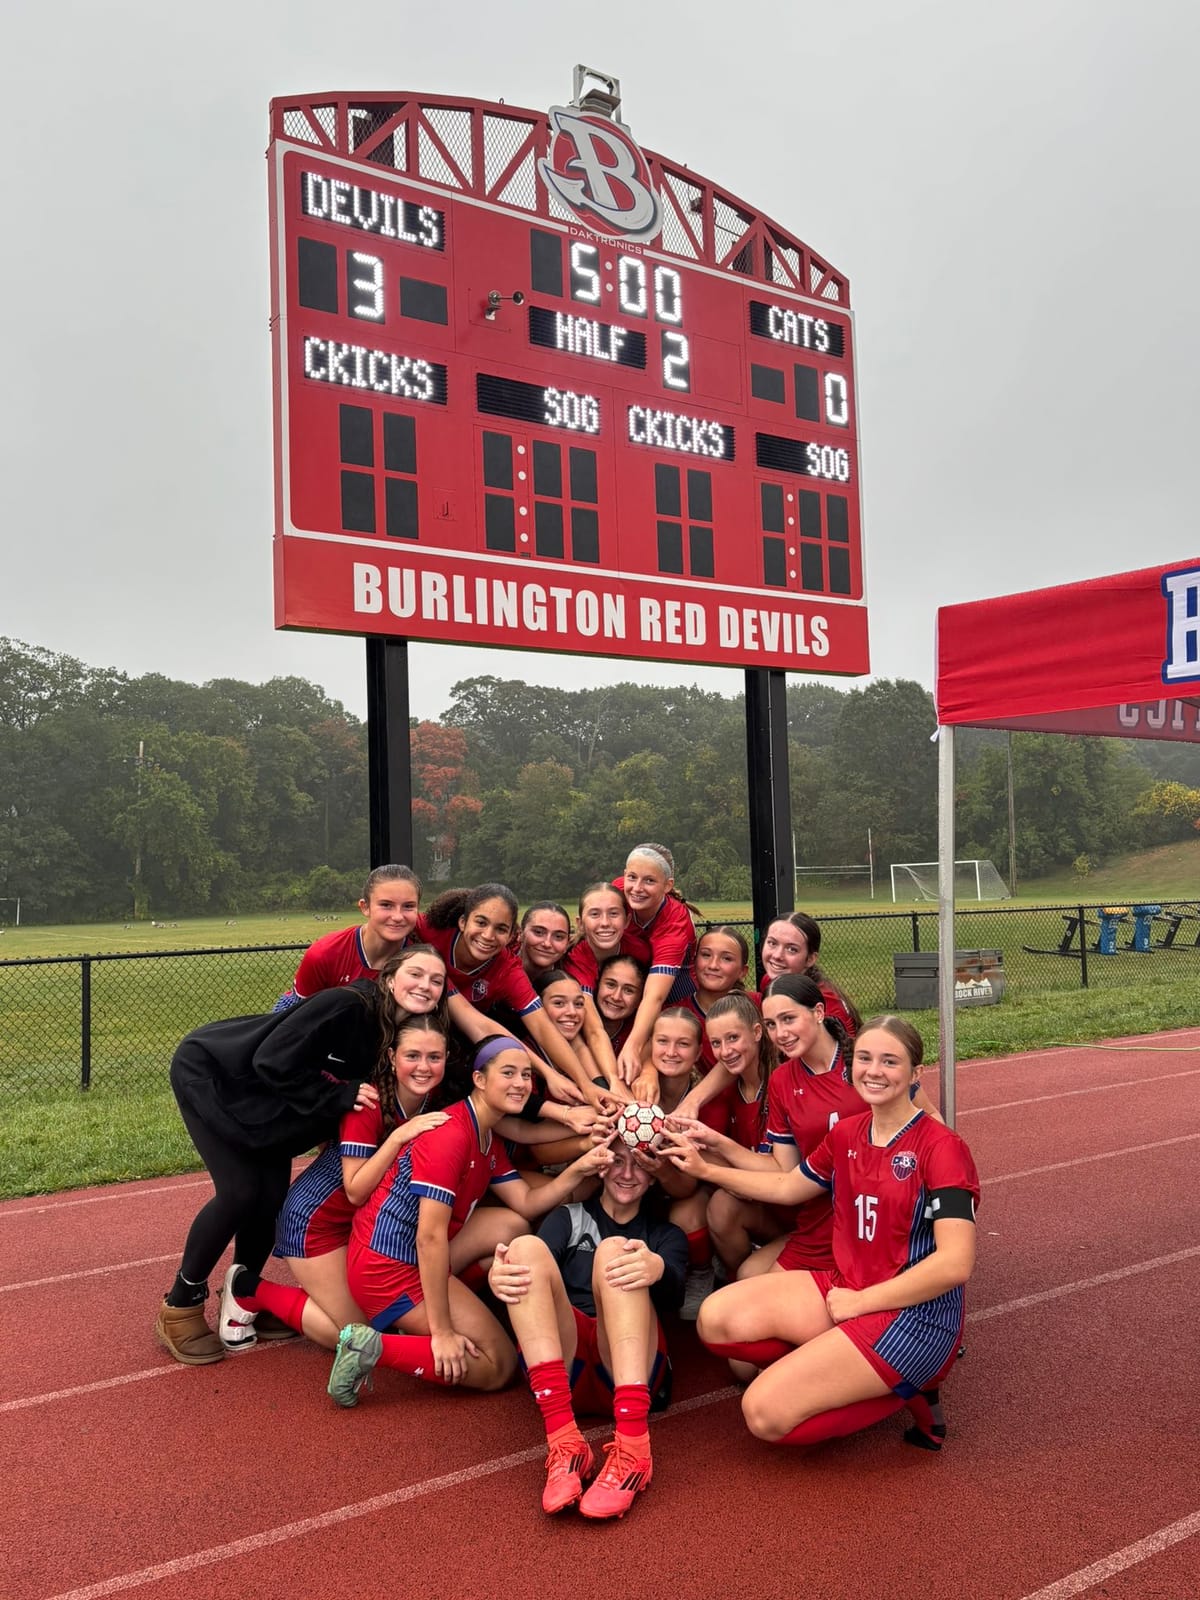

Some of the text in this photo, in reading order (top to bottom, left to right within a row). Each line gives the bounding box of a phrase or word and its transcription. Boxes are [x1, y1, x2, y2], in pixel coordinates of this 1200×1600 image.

[306, 171, 439, 248] DEVILS
[570, 226, 642, 255] DAKTRONICS
[352, 251, 385, 318] 3
[571, 242, 683, 322] 5:00
[555, 311, 628, 361] HALF
[768, 305, 829, 352] CATS
[304, 336, 434, 400] CKICKS
[663, 331, 690, 388] 2
[543, 386, 600, 434] SOG
[824, 372, 849, 425] 0
[627, 404, 726, 458] CKICKS
[805, 442, 850, 482] SOG
[353, 561, 830, 657] BURLINGTON RED DEVILS
[854, 1193, 879, 1243] 15
